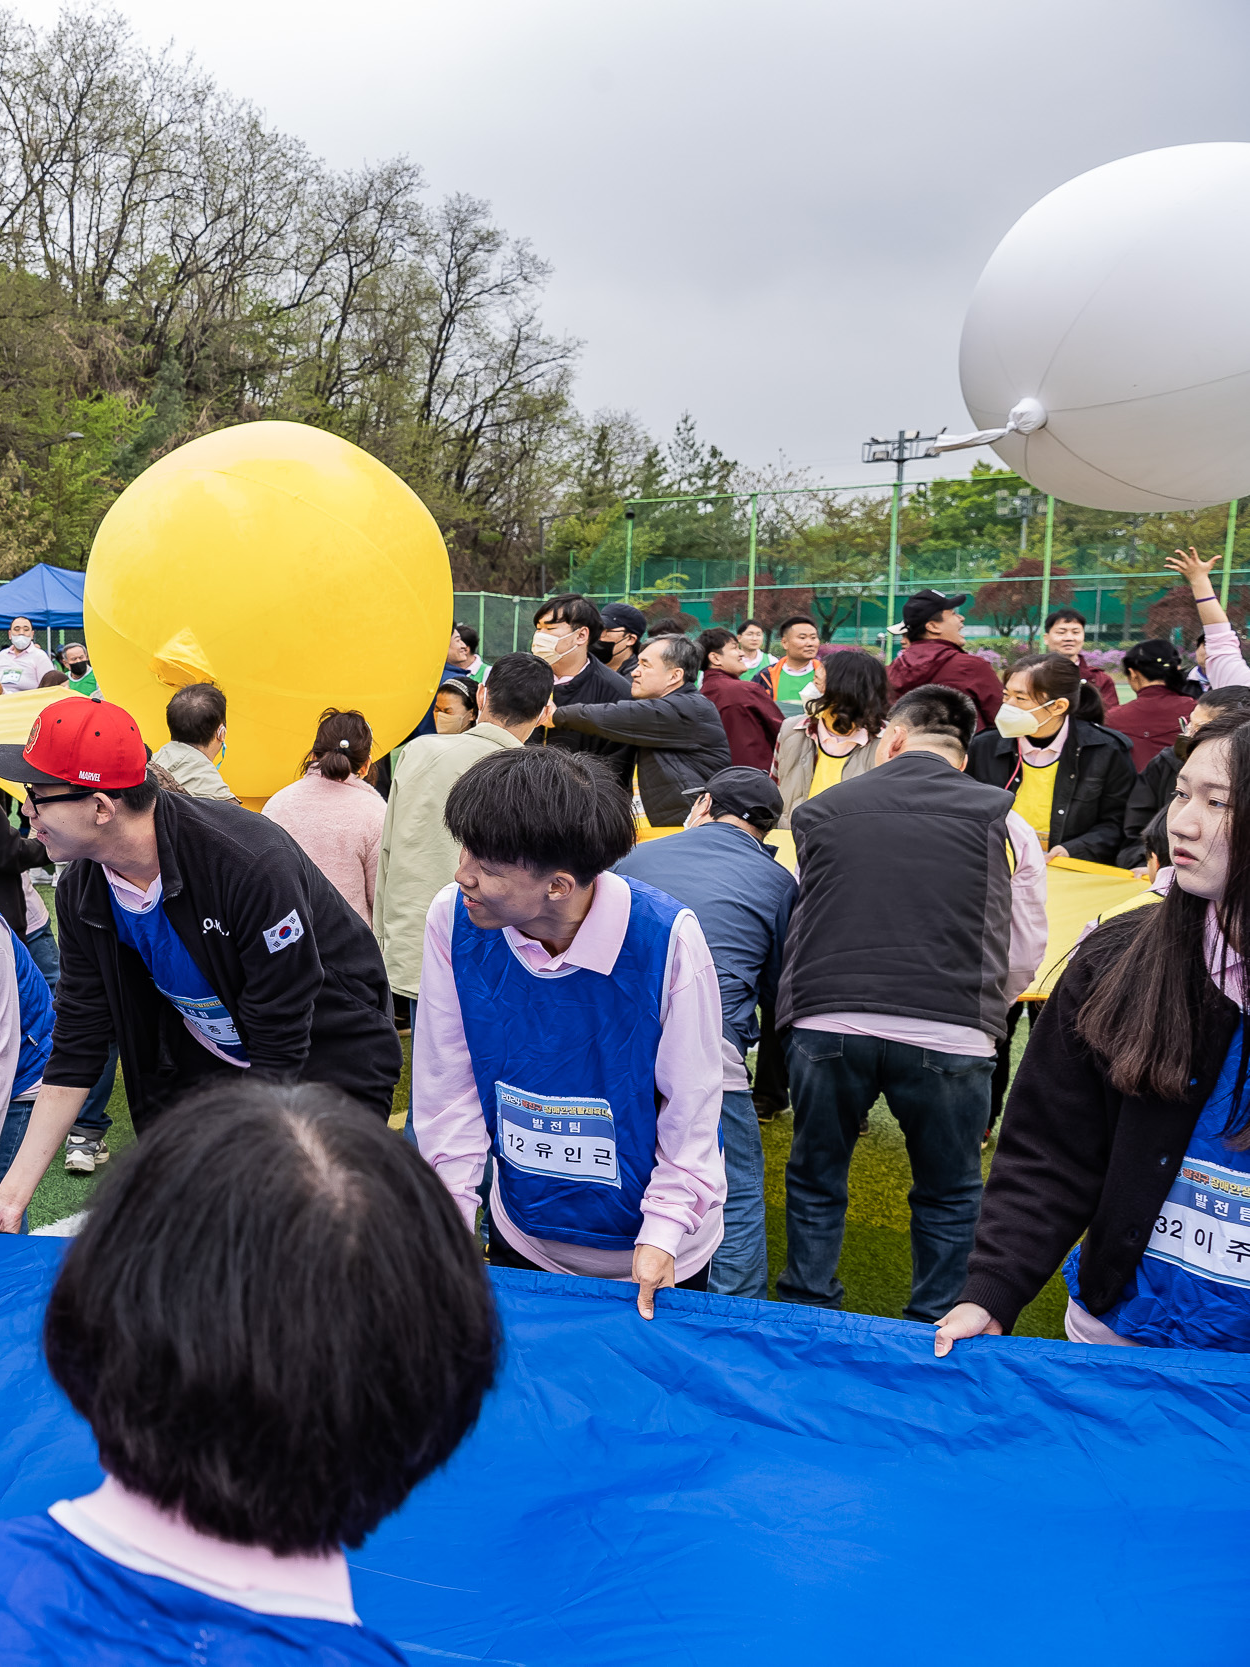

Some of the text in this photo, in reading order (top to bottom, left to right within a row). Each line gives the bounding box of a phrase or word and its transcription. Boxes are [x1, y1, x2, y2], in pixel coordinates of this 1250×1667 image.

[78, 770, 101, 782] MARVEL
[508, 1133, 525, 1153] 12
[1154, 1215, 1183, 1240] 32
